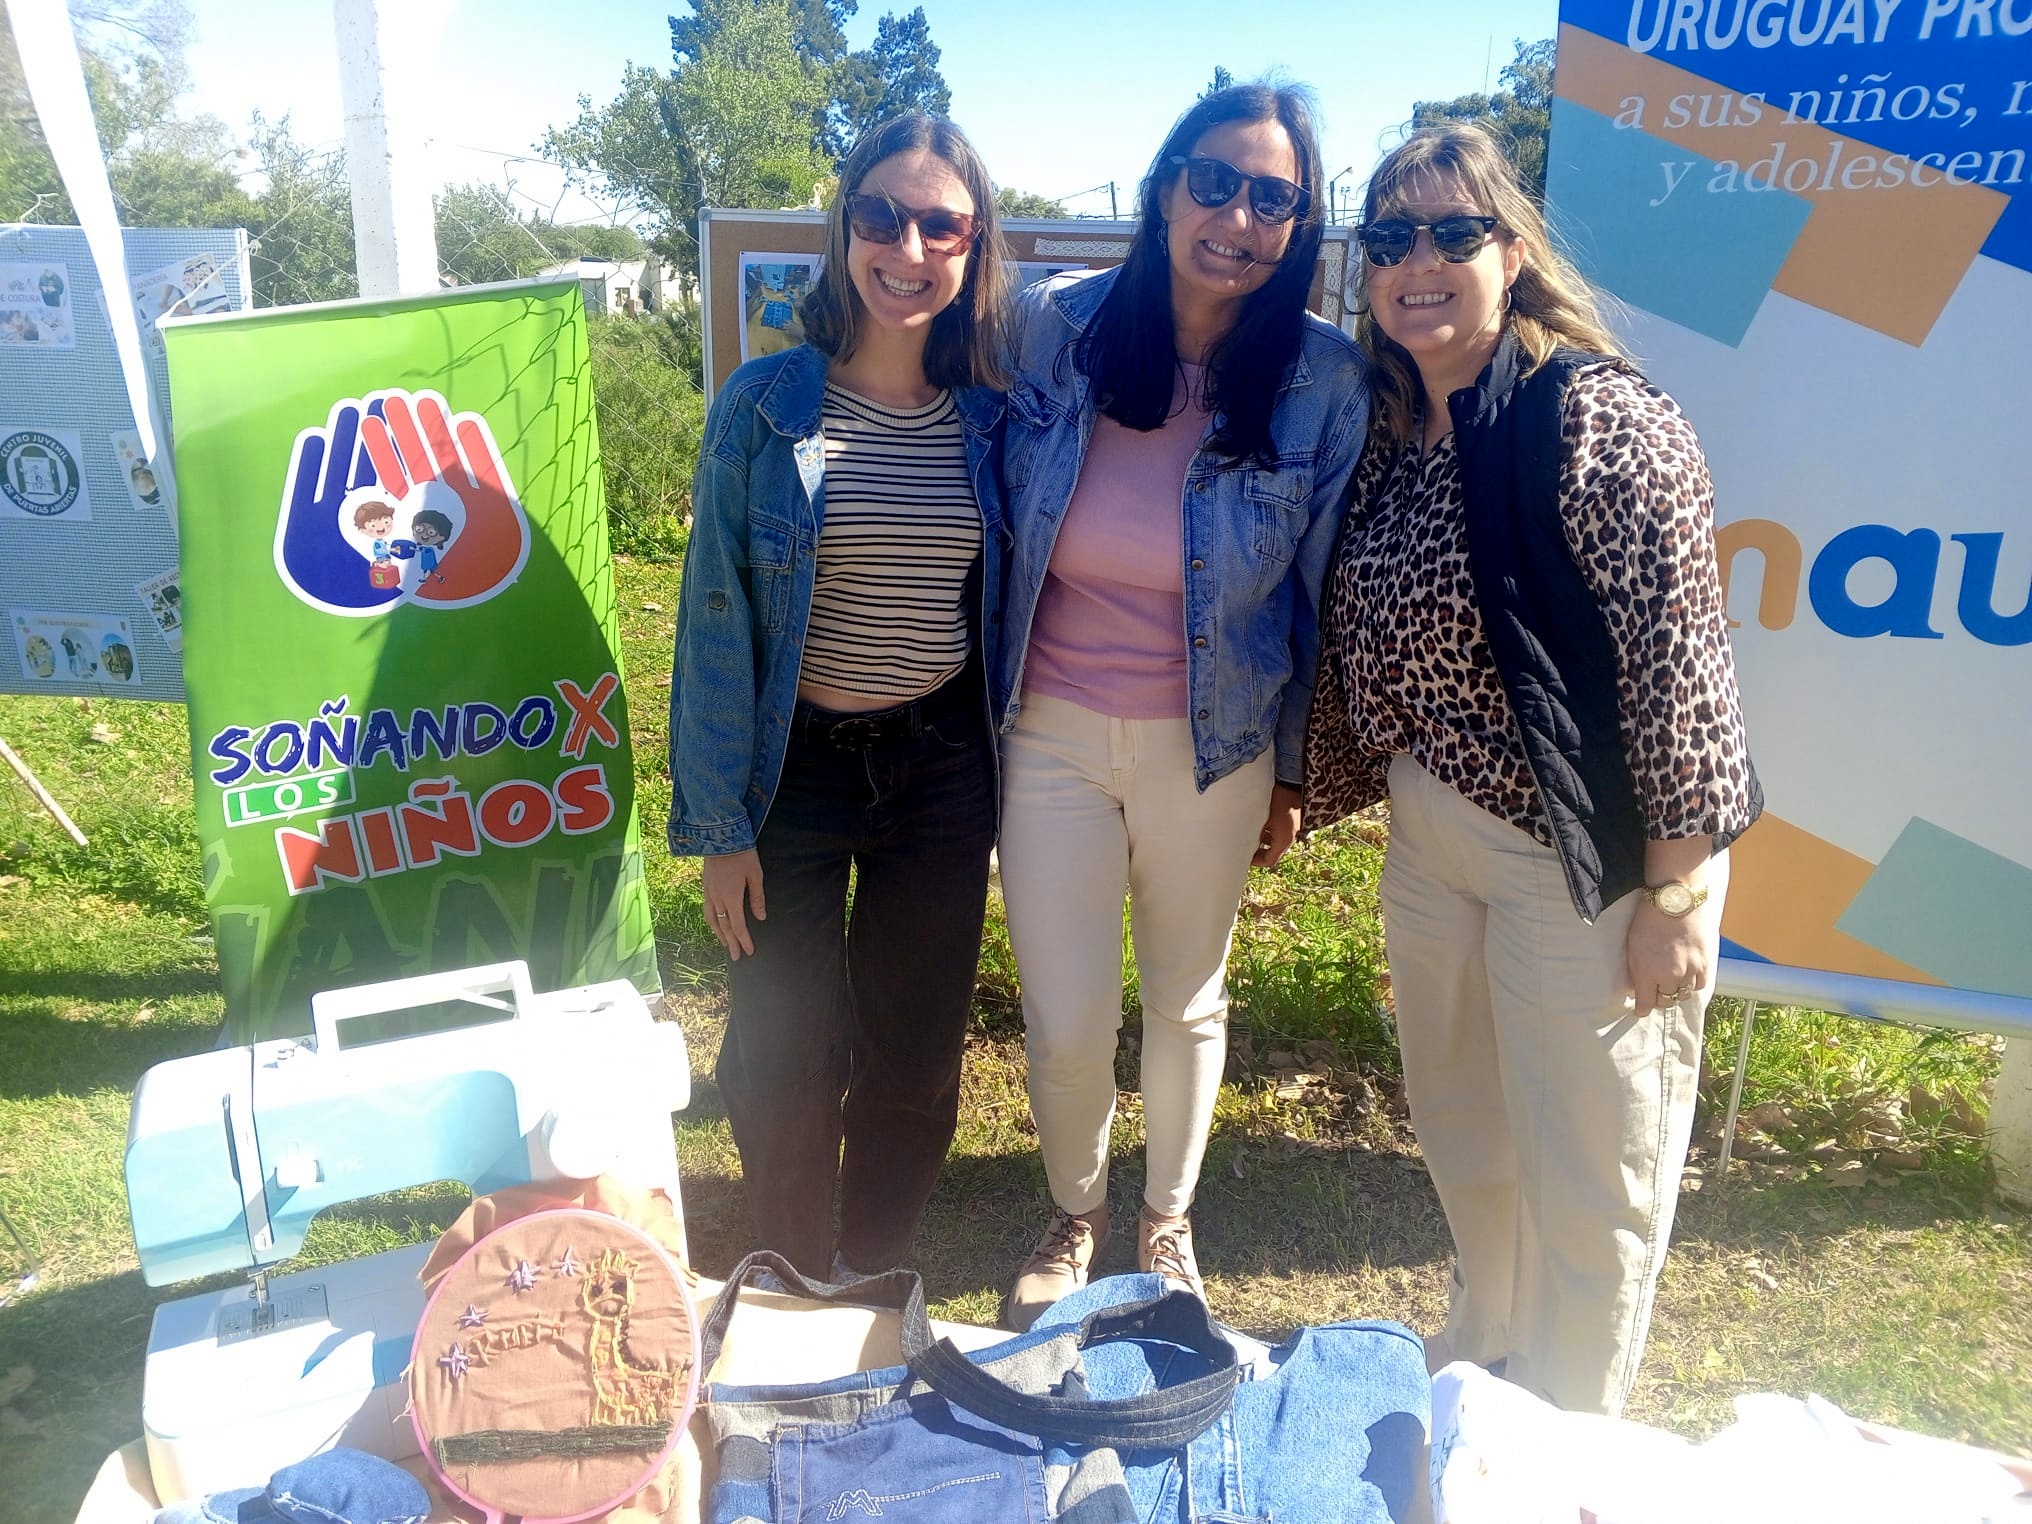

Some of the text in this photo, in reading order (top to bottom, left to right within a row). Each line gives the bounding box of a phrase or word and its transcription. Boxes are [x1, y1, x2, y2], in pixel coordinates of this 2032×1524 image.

[1627, 0, 1899, 53] URUGUAY
[1612, 95, 1645, 129] a
[1663, 91, 1765, 128] sus
[1781, 72, 1978, 127] niños,
[1650, 141, 2032, 207] y adolescen
[1, 434, 69, 461] CENTRO JUVENIL
[209, 672, 621, 785] SOÑANDO X
[237, 774, 340, 820] LOS
[274, 764, 615, 897] NIÑOS
